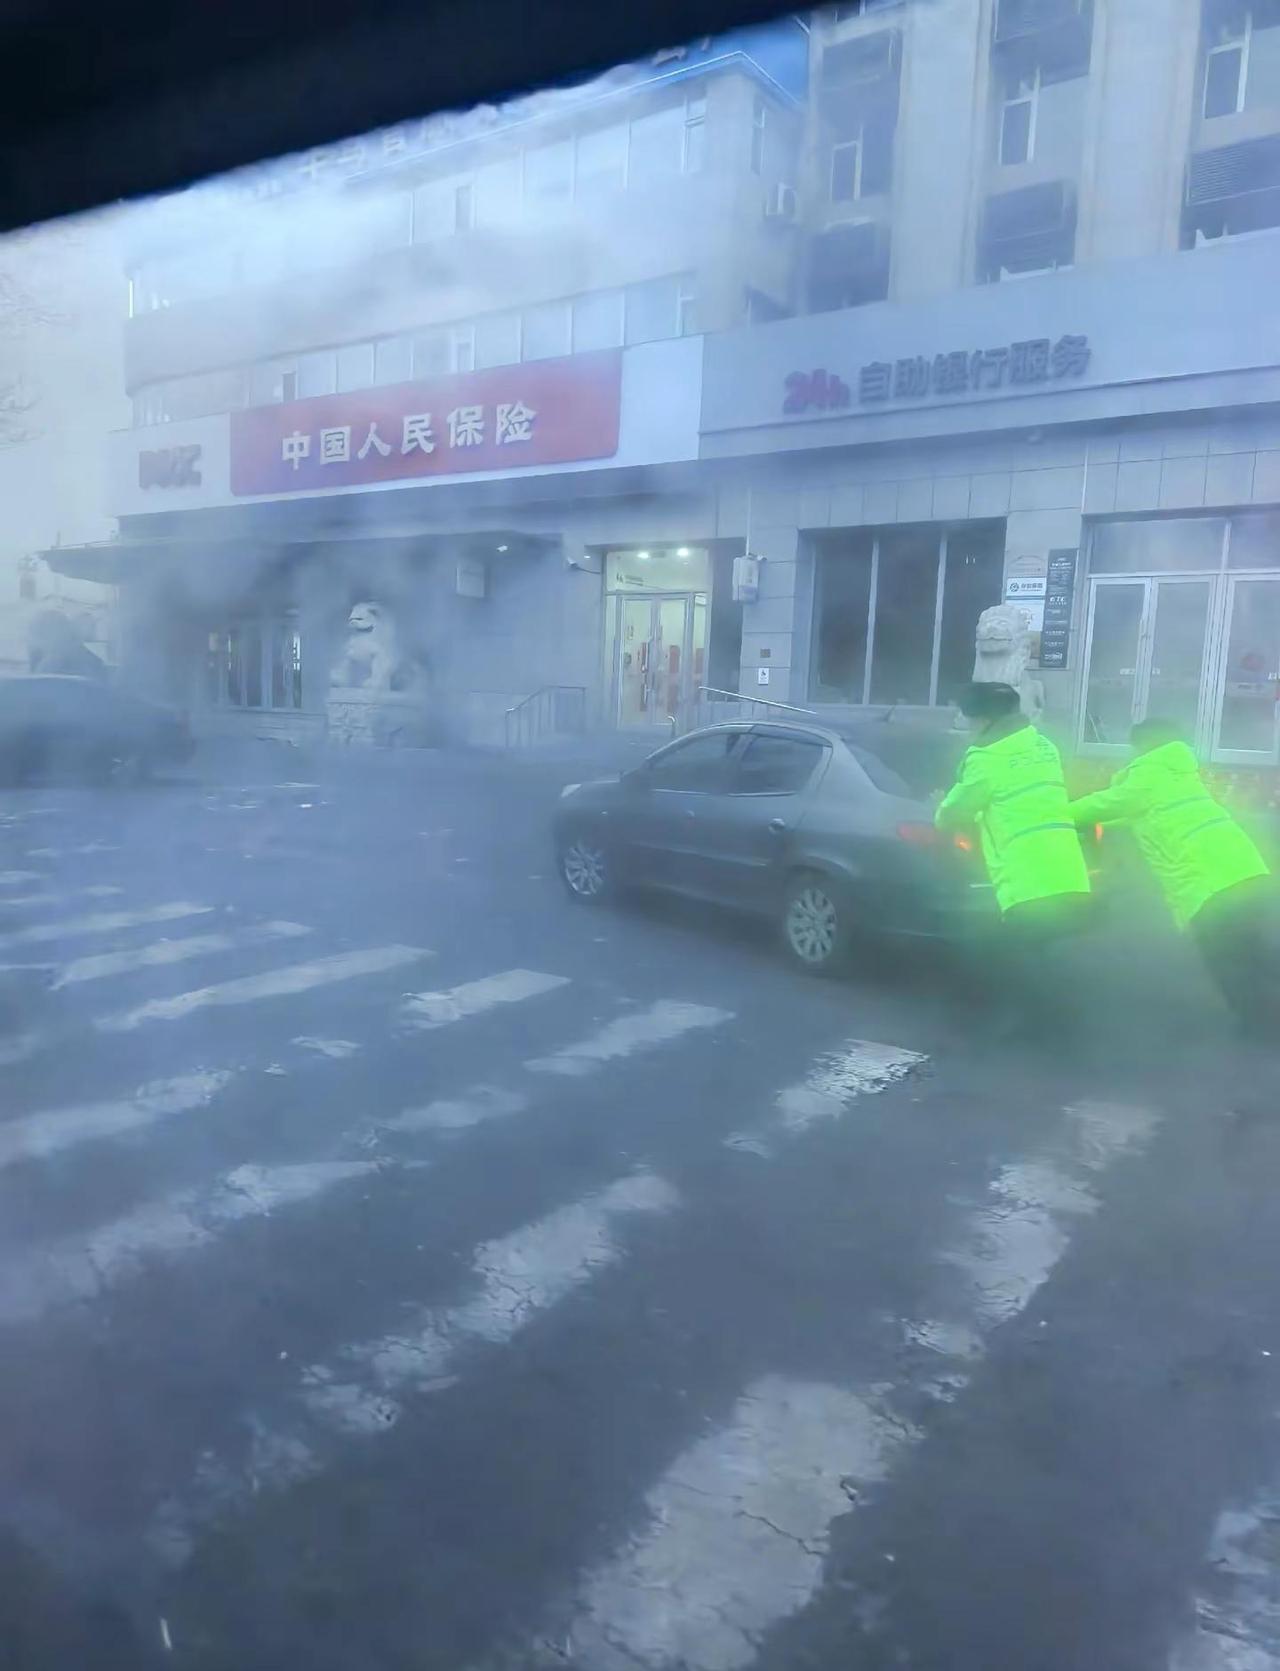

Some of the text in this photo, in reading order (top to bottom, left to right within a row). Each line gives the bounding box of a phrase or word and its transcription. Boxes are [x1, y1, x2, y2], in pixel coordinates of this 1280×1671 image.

[282, 400, 537, 470] 中国人民保险
